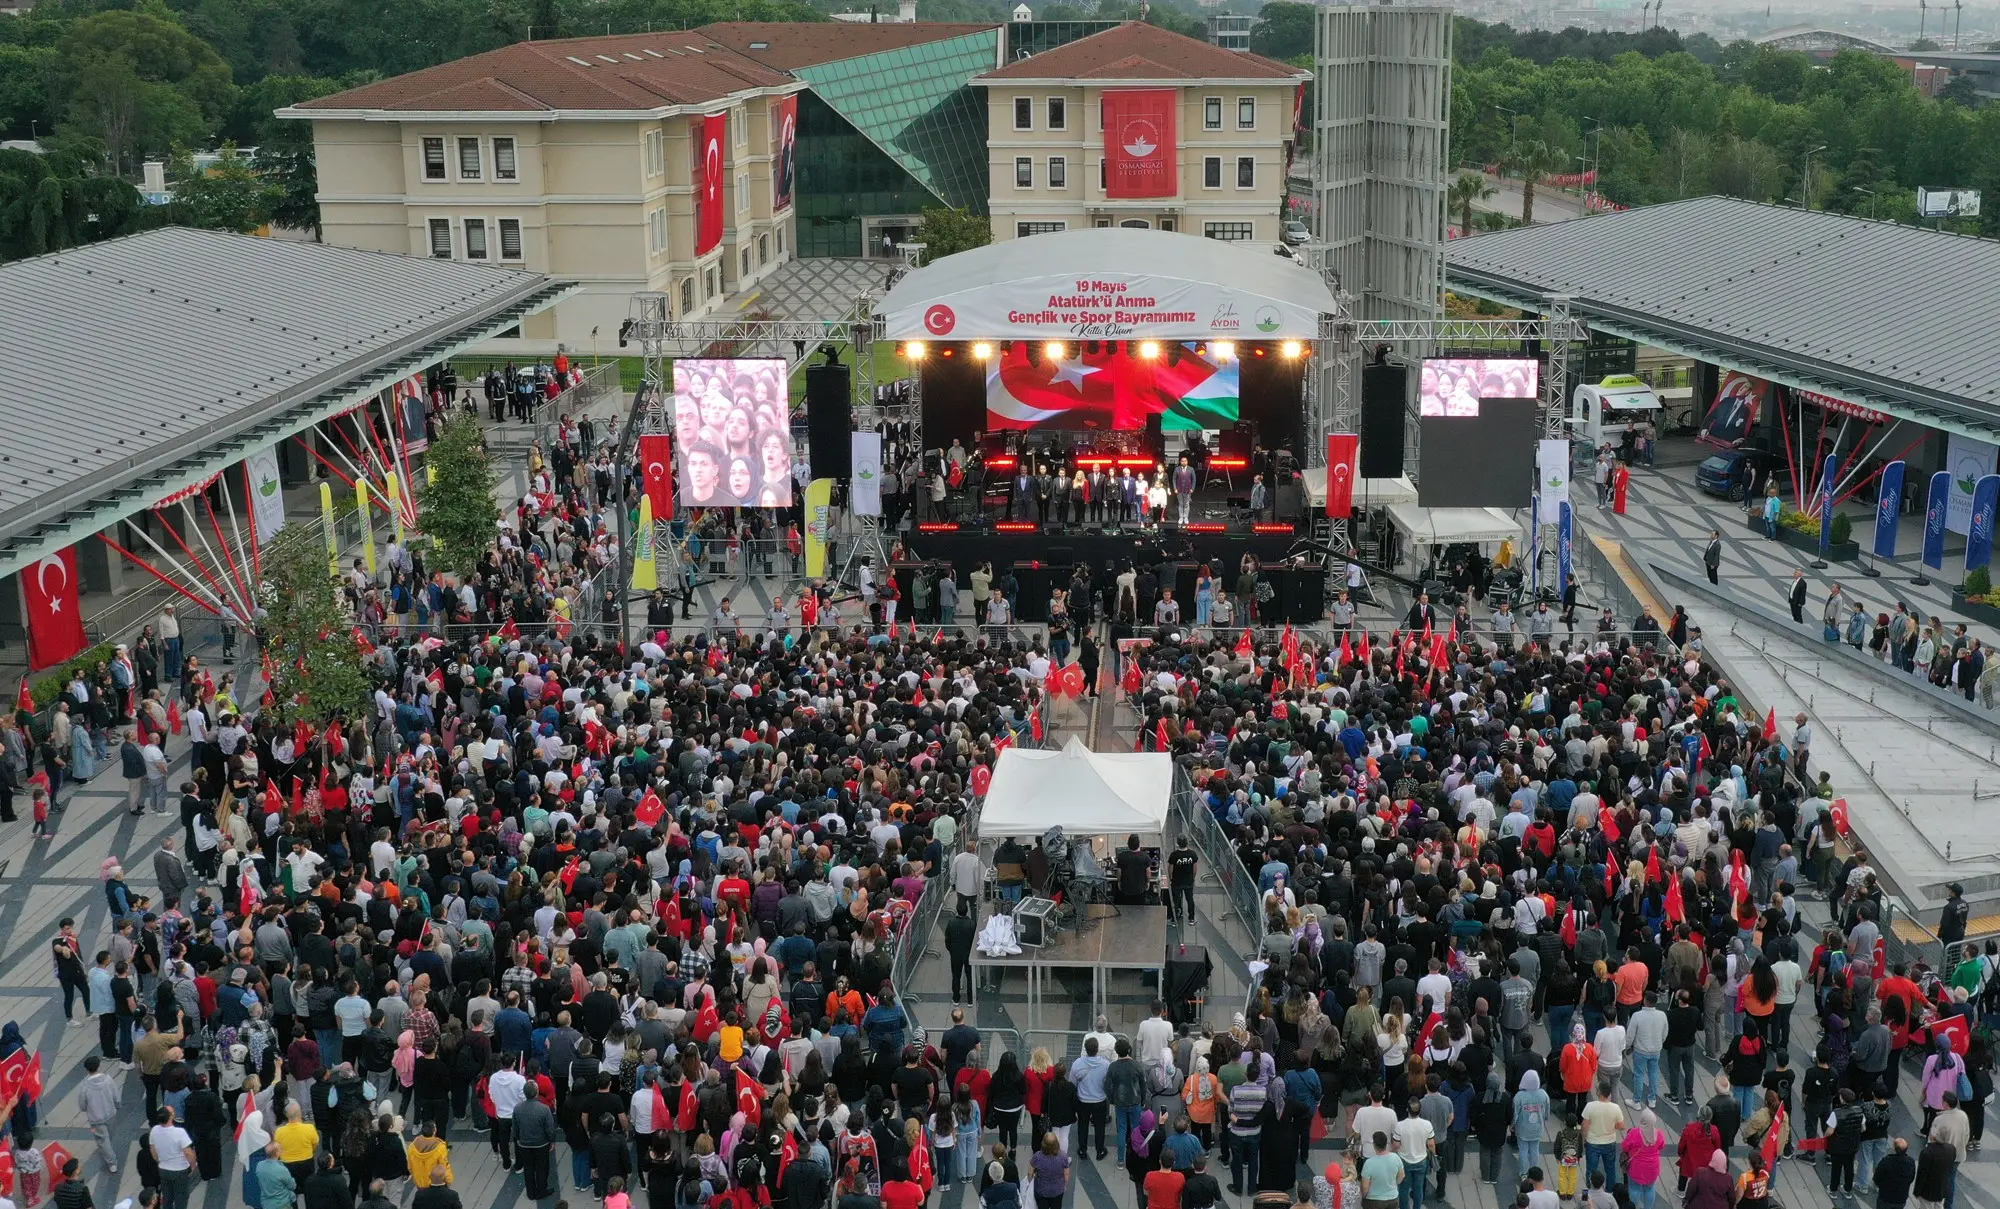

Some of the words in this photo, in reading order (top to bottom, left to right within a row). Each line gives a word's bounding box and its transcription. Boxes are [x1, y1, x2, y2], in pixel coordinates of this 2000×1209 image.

[1118, 161, 1163, 169] OSMANGAZİ
[1075, 280, 1089, 292] 19
[1092, 281, 1127, 294] Mayıs
[1115, 296, 1156, 308] Anma
[1008, 311, 1058, 325] Gençlik
[1061, 314, 1077, 324] ve
[1080, 311, 1112, 326] Spor
[1114, 311, 1196, 326] Bayramımız
[1070, 323, 1103, 337] Kutlu
[1105, 323, 1134, 337] Olsun
